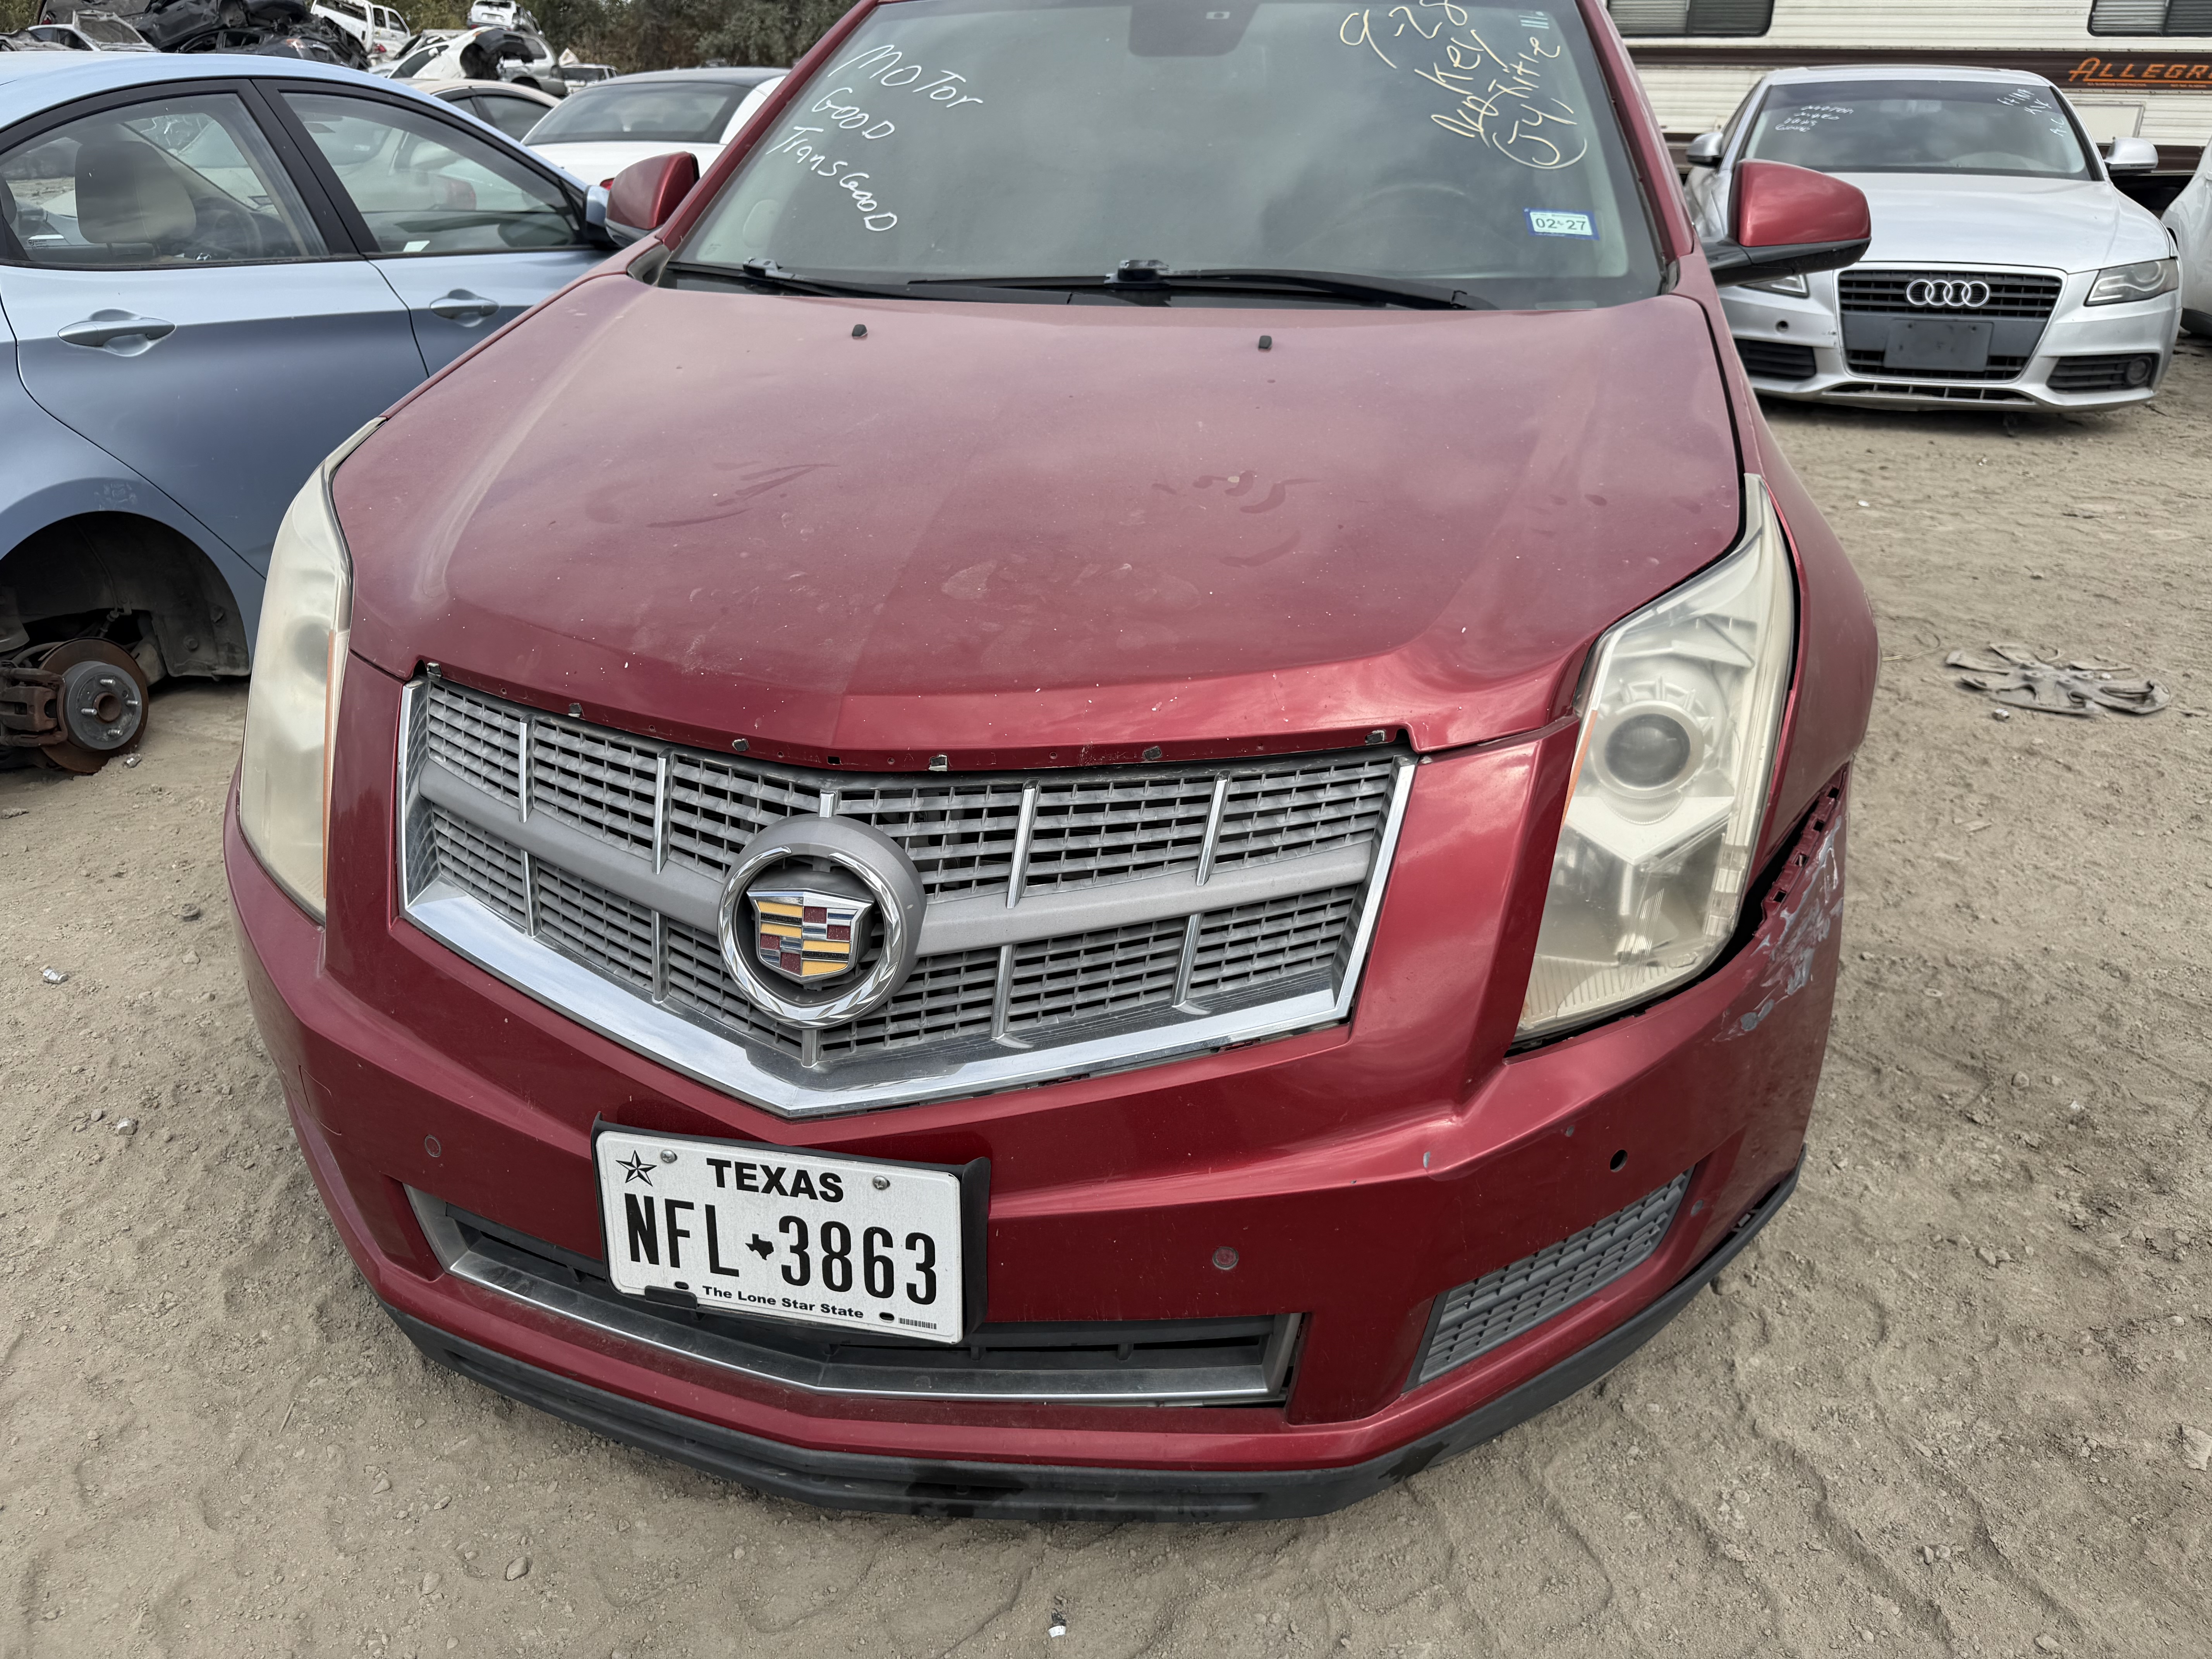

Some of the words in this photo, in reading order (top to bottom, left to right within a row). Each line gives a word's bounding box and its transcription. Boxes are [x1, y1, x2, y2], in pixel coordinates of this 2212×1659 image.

[2068, 57, 2212, 82] ALLEGR
[706, 1158, 843, 1203] TEXAS
[624, 1193, 739, 1277] NFL
[779, 1216, 937, 1305] 3863
[702, 1285, 732, 1298] The
[738, 1291, 776, 1305] Lone
[782, 1298, 815, 1311] Star
[821, 1304, 864, 1318] State
